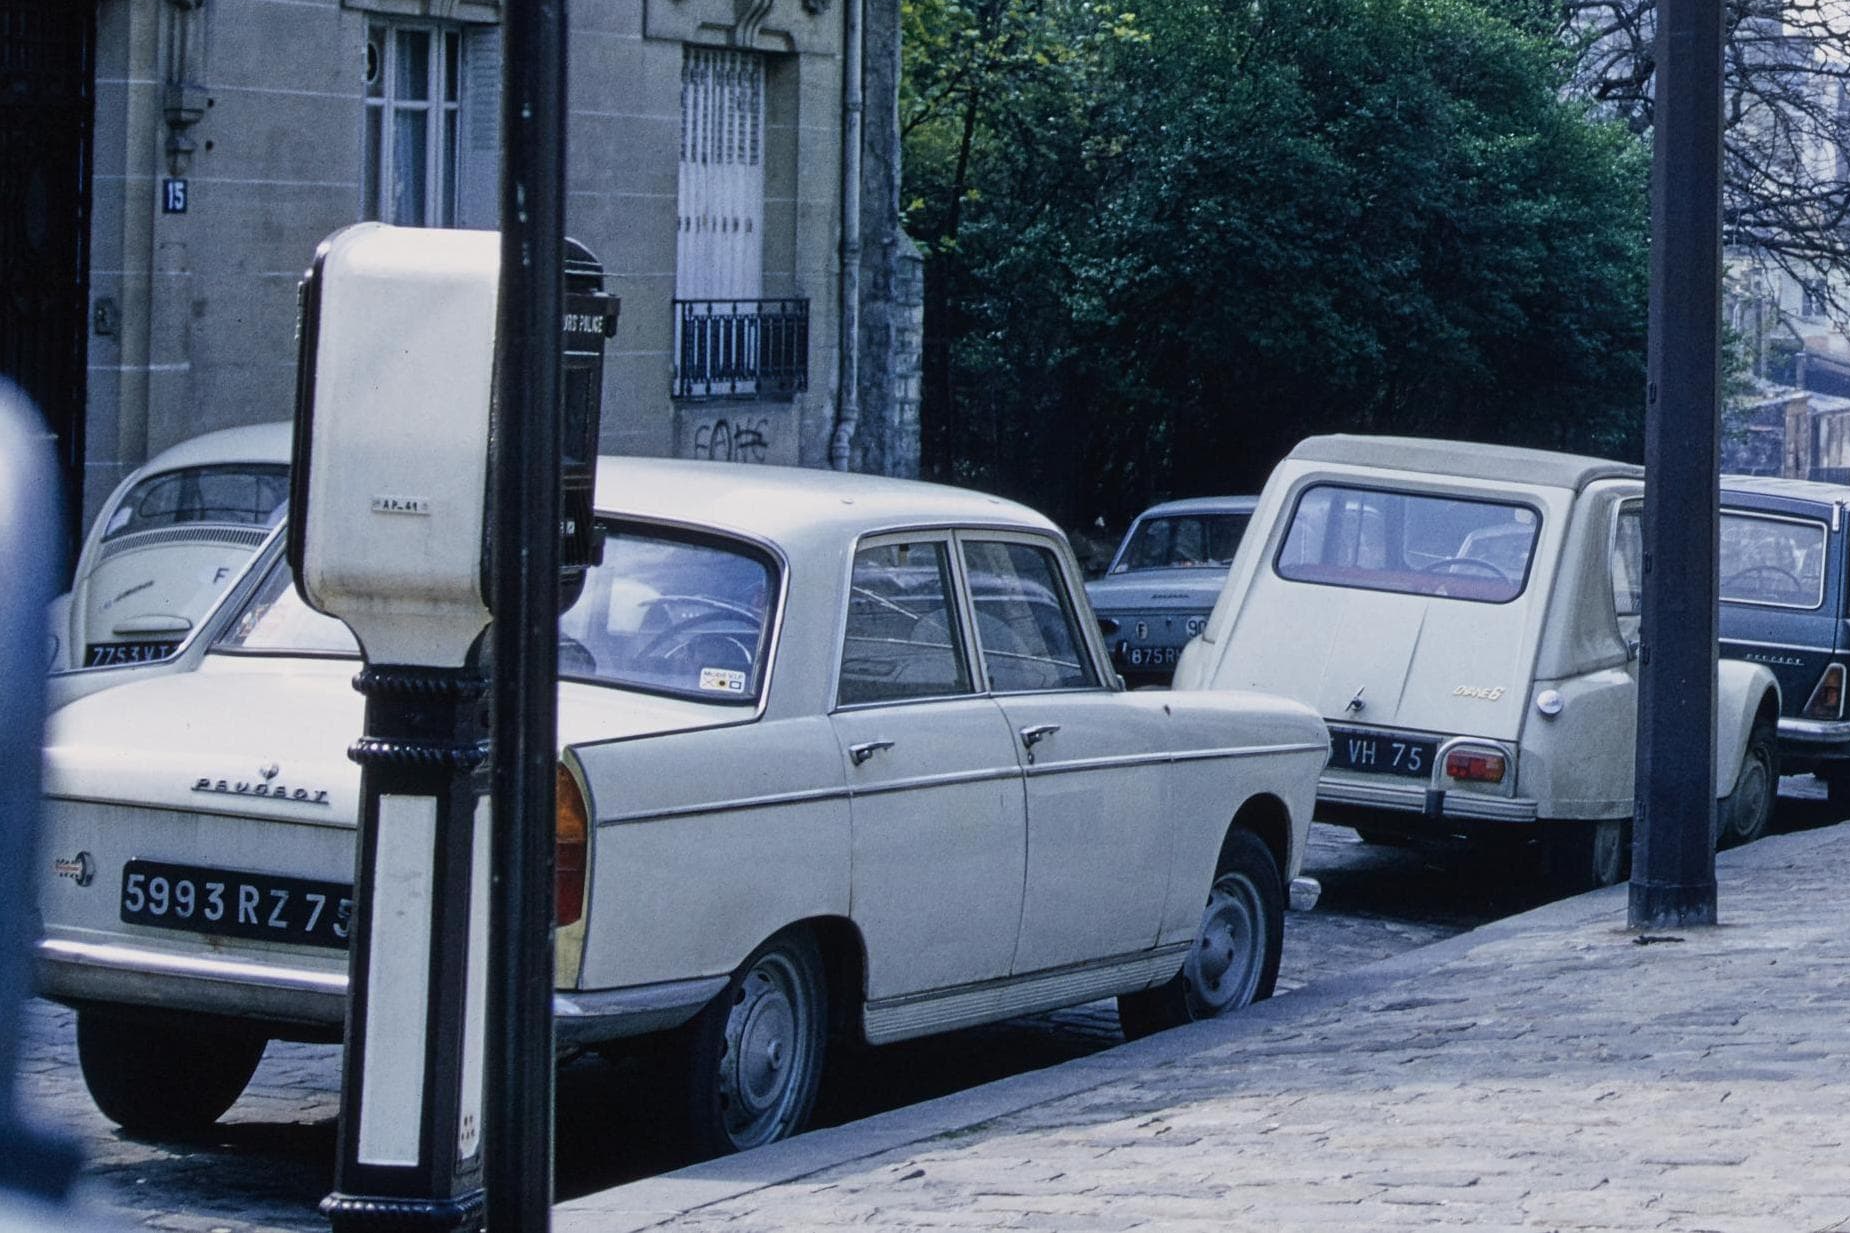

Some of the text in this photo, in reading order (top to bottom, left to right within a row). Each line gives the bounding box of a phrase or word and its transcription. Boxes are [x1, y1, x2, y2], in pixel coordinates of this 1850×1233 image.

[167, 181, 185, 210] 15
[213, 567, 230, 584] F
[1137, 623, 1146, 639] F
[1348, 738, 1423, 771] VH 75
[194, 777, 329, 804] PEUGEOT
[125, 873, 226, 921] 5993
[237, 884, 291, 929] RZ
